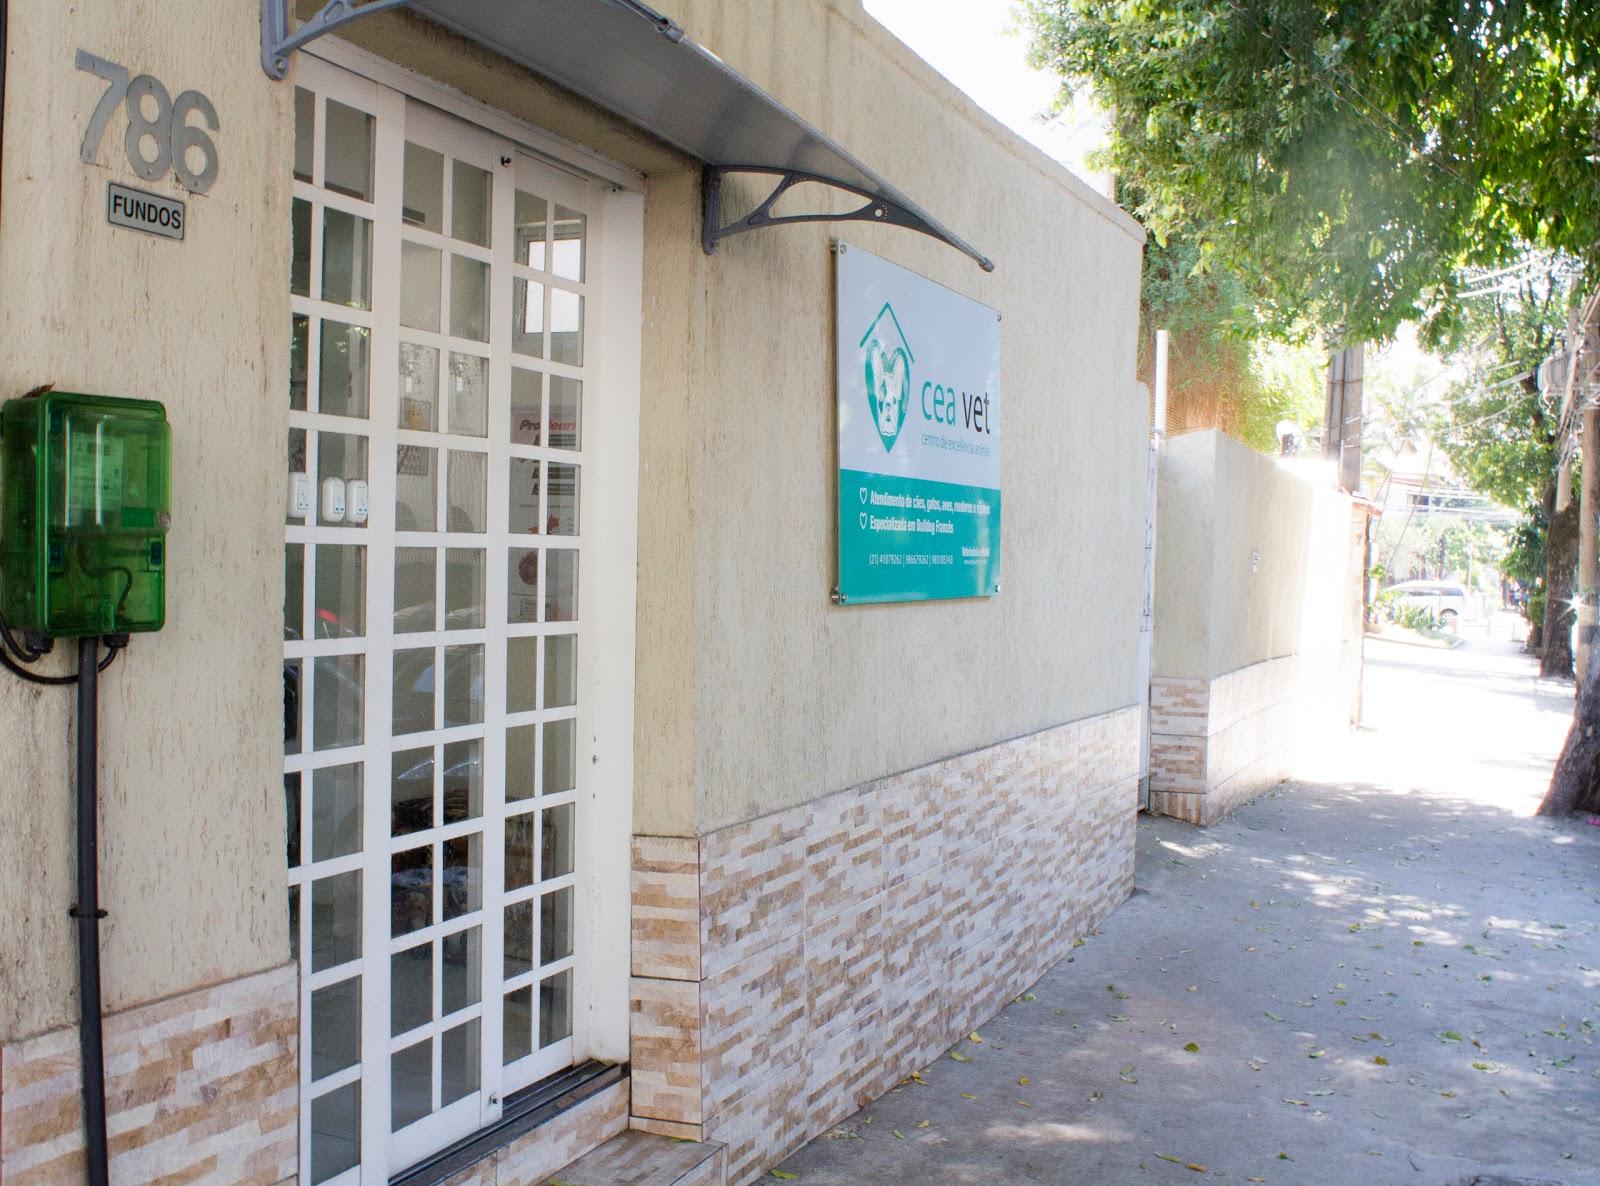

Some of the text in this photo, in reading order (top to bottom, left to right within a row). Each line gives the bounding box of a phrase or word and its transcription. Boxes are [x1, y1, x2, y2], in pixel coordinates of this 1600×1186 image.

[75, 48, 220, 193] 786
[113, 194, 181, 230] FUNDOS
[922, 381, 990, 434] cea vet
[870, 490, 905, 507] Atendimento
[905, 494, 912, 508] de
[913, 495, 926, 511] cães,
[927, 497, 941, 512] gatos,
[907, 520, 916, 531] em
